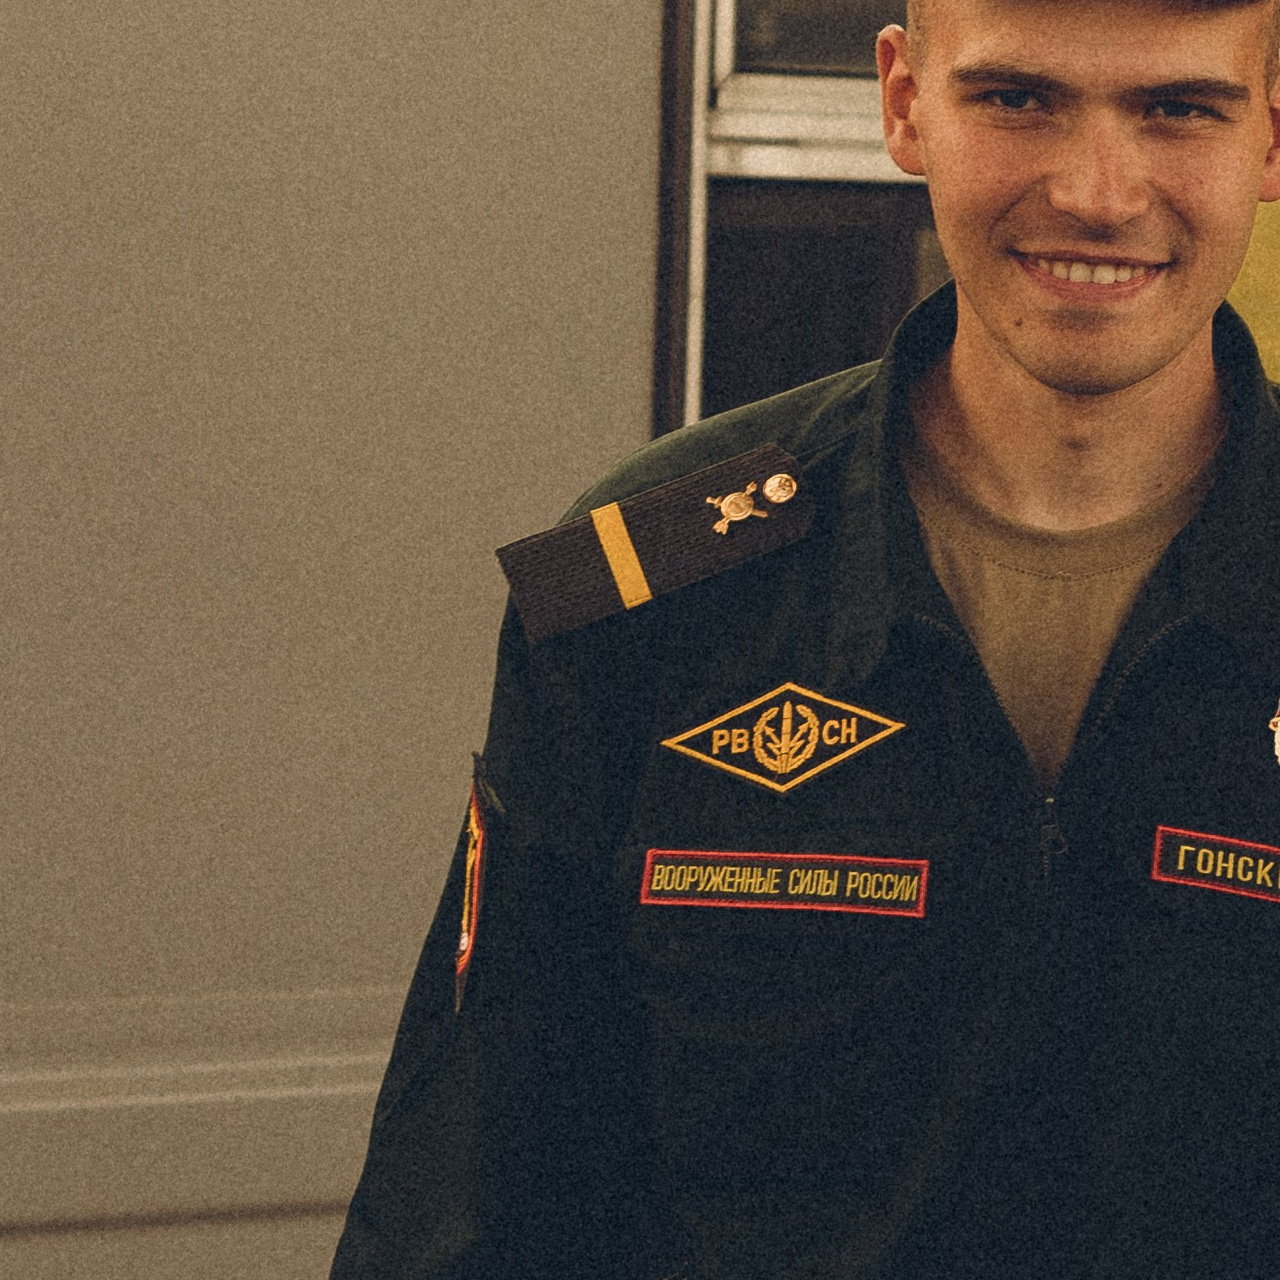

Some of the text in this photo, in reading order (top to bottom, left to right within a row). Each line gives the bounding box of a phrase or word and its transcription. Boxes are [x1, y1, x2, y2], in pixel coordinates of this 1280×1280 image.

[711, 718, 858, 754] РВ СН
[650, 864, 919, 902] ВООРУЖЕННЫЕ СИЛЫ РОССИИ
